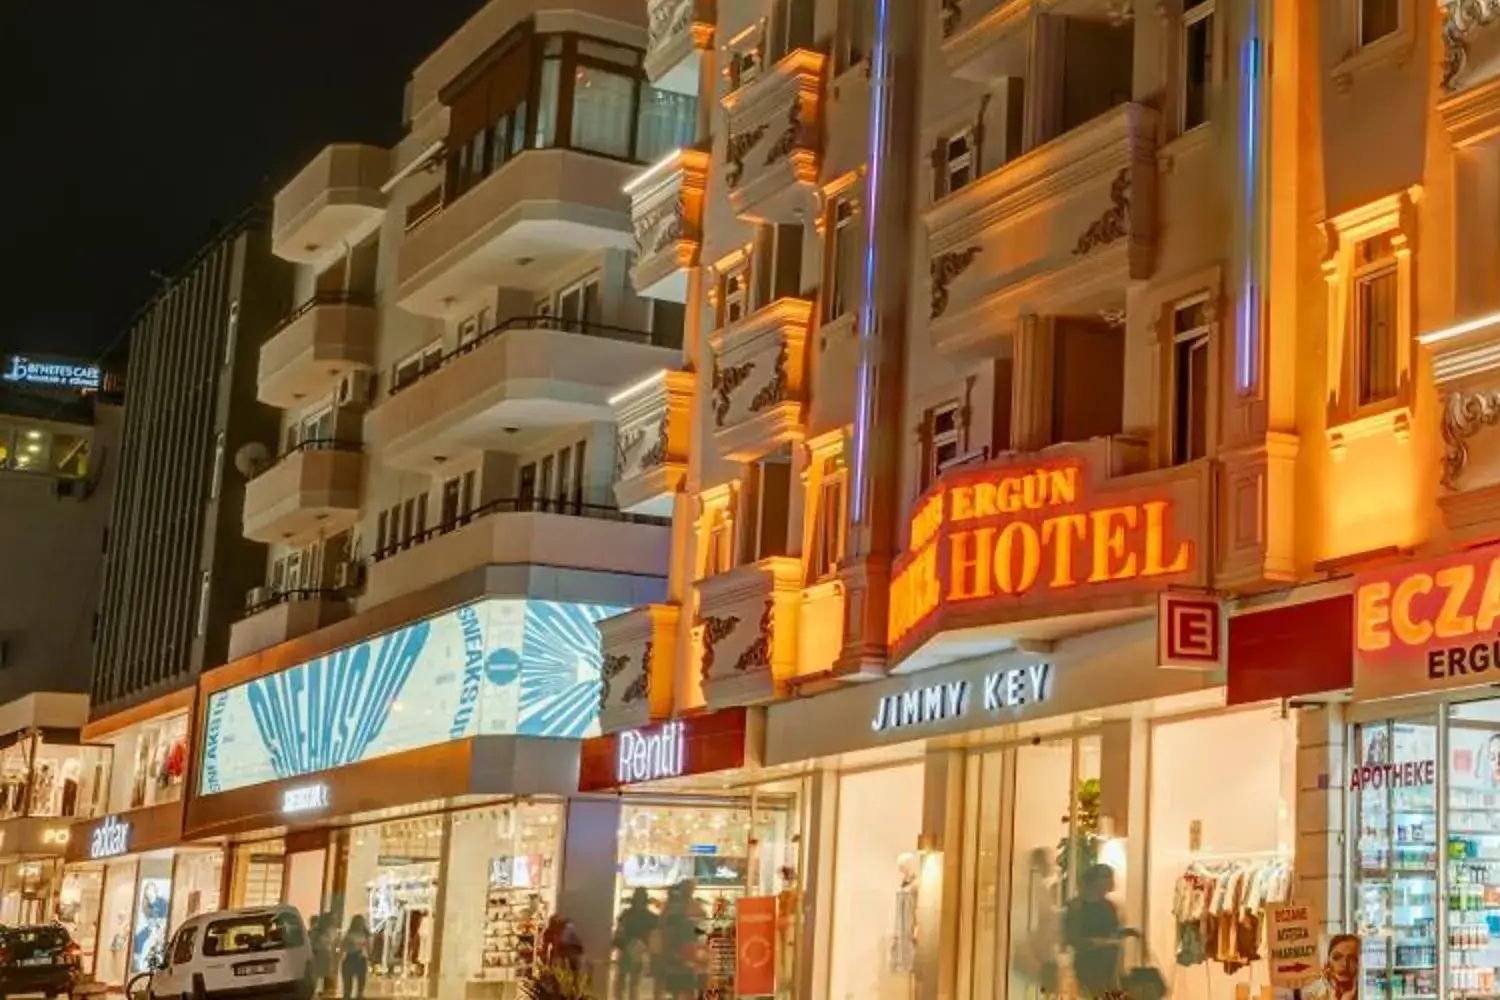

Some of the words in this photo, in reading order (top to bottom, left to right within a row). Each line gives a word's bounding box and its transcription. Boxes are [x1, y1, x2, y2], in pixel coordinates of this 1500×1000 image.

[946, 501, 1191, 601] HOTEL
[871, 681, 968, 731] JIMMY
[984, 664, 1051, 711] KEY
[1350, 759, 1435, 792] APOTHEKE
[91, 815, 130, 859] addax
